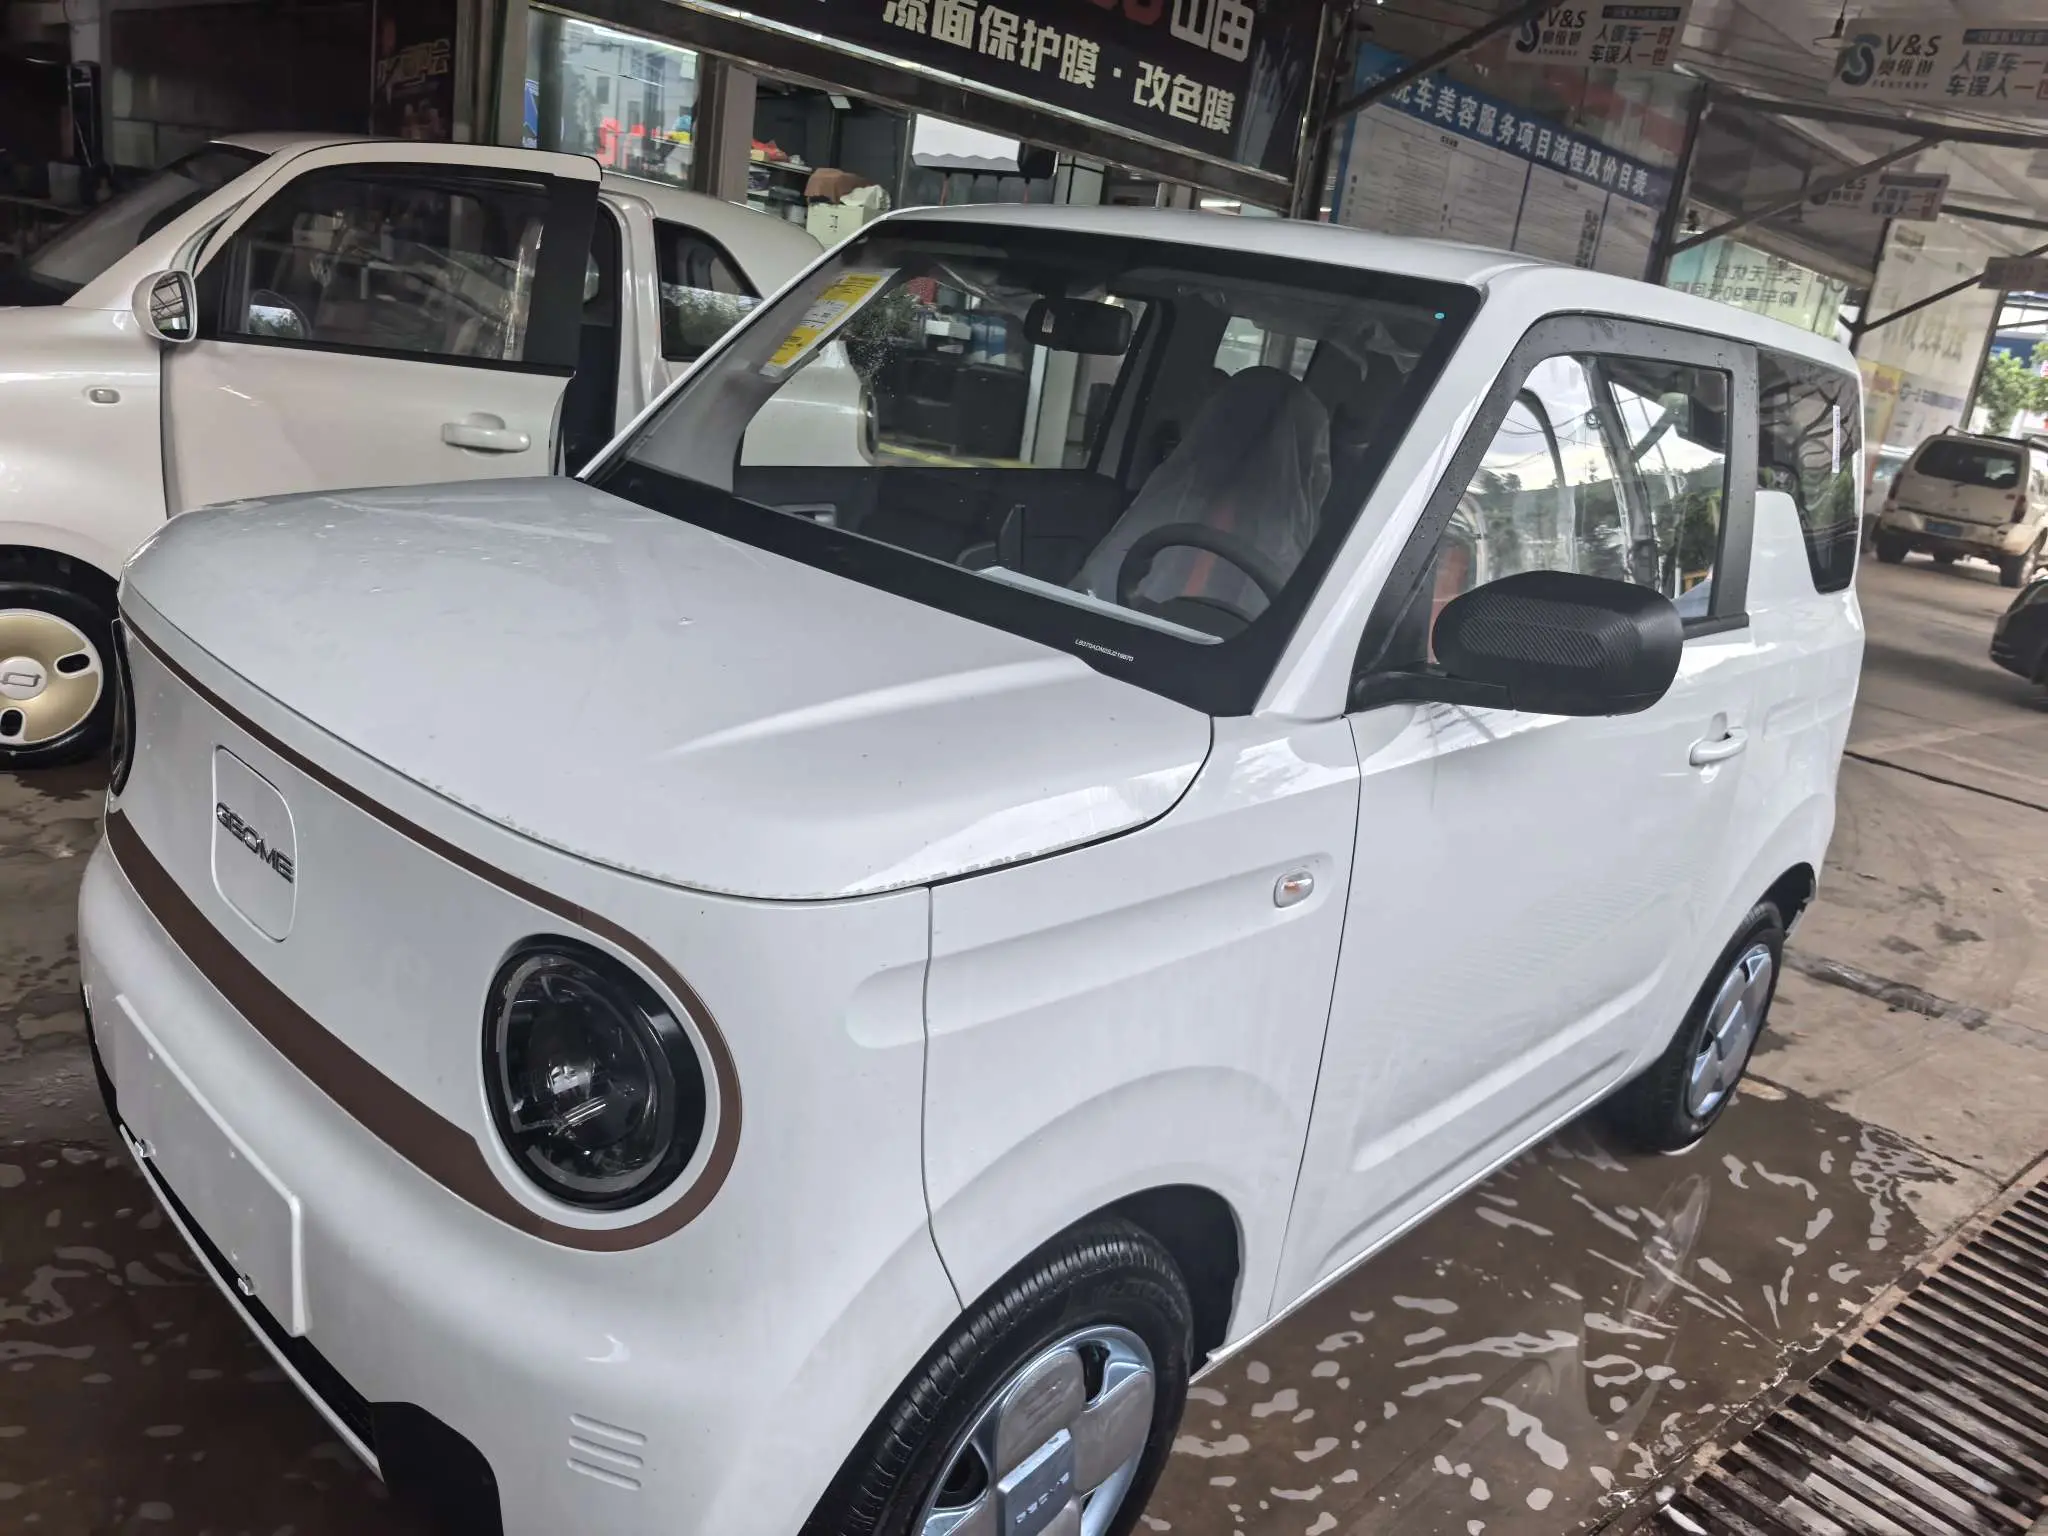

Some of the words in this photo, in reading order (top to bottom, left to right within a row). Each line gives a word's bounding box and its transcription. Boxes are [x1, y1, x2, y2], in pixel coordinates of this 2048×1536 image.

[1547, 8, 1587, 28] V&S
[1886, 33, 1942, 56] V&S
[1953, 49, 2048, 74] 人误车一
[216, 801, 294, 884] GEOME
